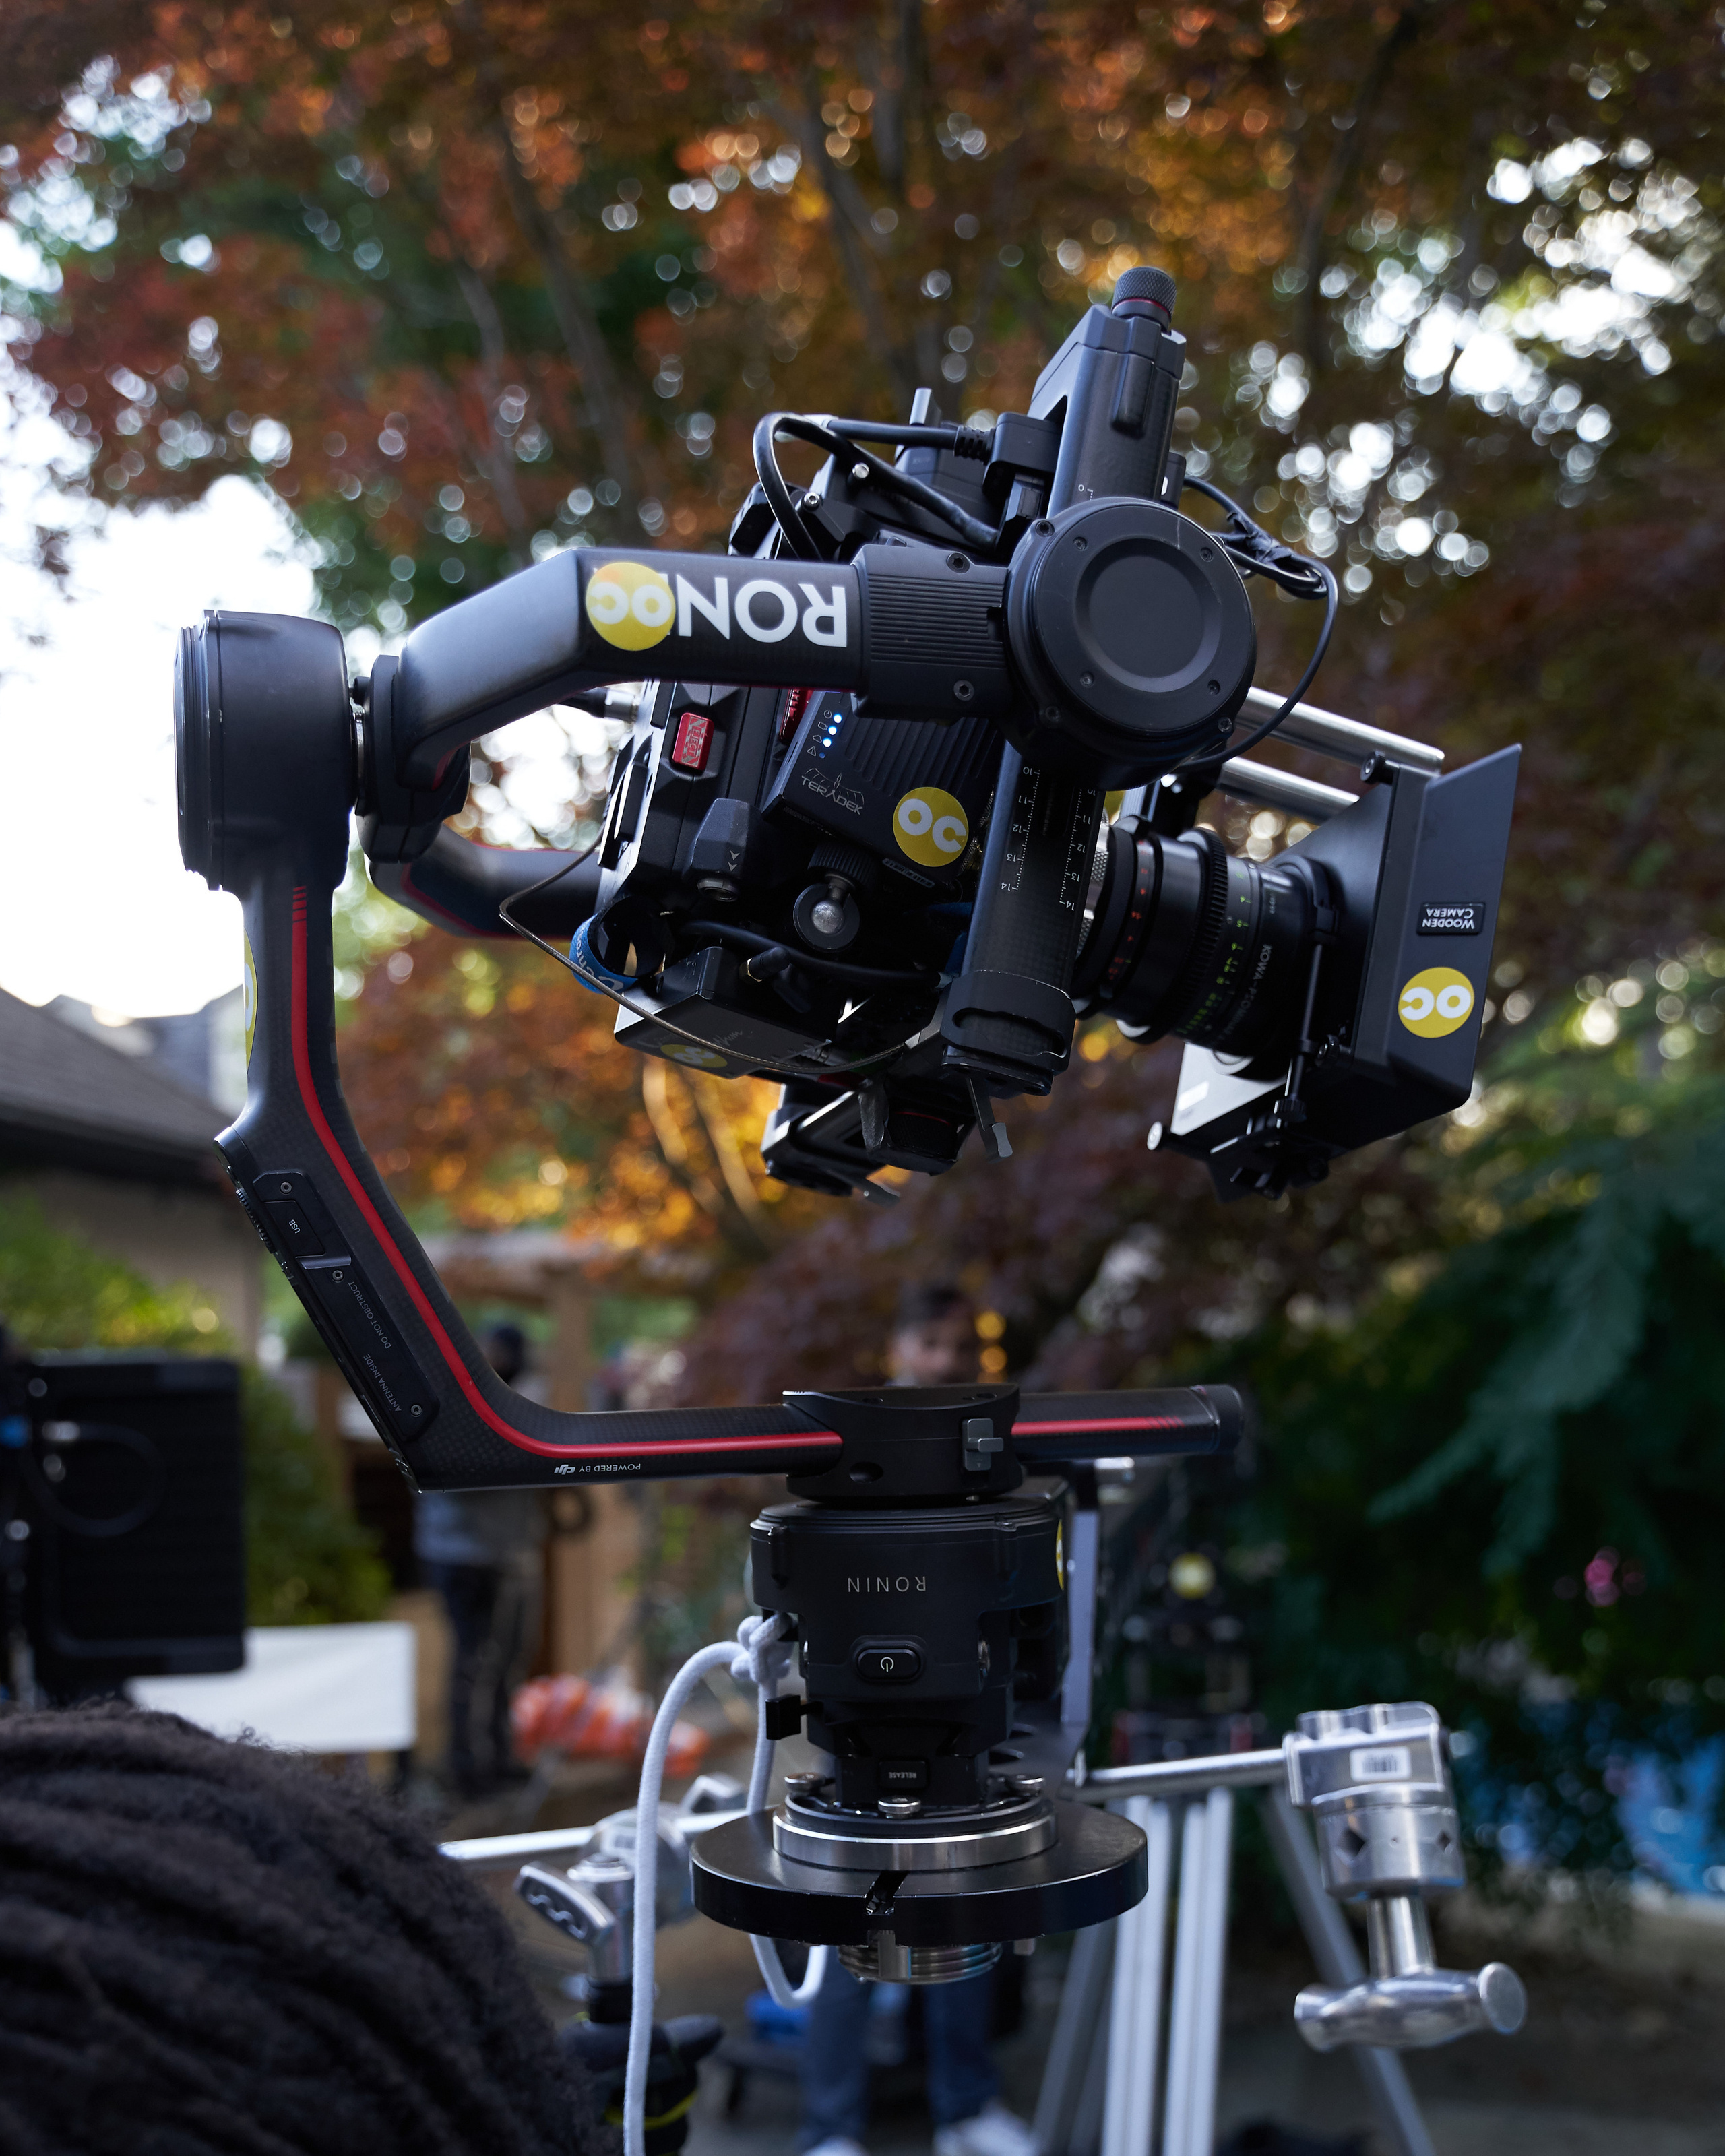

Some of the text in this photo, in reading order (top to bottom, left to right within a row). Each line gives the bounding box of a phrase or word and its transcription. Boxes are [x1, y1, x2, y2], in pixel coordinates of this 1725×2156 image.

[687, 728, 701, 756] EJECT
[1023, 767, 1033, 775] 10
[801, 775, 864, 815] TERADEK
[1018, 795, 1028, 804] 11
[1083, 815, 1091, 825] 11
[1012, 824, 1022, 833] 12
[1077, 843, 1086, 854] 12
[1007, 853, 1016, 862] 13
[1071, 872, 1080, 882] 13
[1001, 882, 1011, 891] 14
[1066, 900, 1075, 911] 14
[1426, 908, 1474, 919] CAMERA
[1422, 918, 1475, 930] WOODEN
[288, 1219, 301, 1234] USB
[348, 1281, 391, 1349] DO NOT OBSTRUCT
[363, 1354, 402, 1412] ANTENNA INSIDE
[593, 1463, 641, 1472] POWERED
[848, 1576, 926, 1593] RONIN
